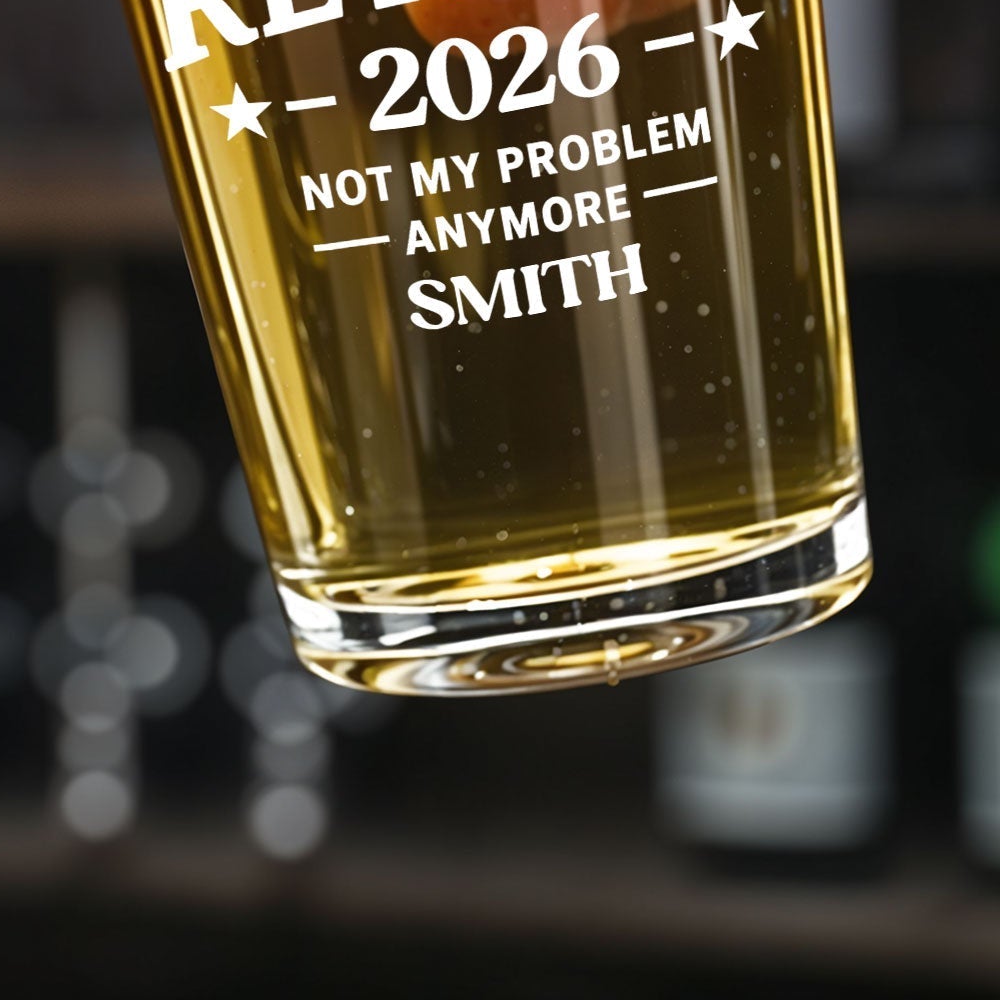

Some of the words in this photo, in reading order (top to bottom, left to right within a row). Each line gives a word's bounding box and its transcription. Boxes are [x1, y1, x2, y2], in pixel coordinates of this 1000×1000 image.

[359, 12, 621, 133] 2026
[300, 165, 393, 211] NOT
[410, 152, 481, 197] MY
[498, 107, 712, 184] PROBLEM
[406, 183, 632, 256] ANYMORE
[407, 242, 648, 331] SMITH
